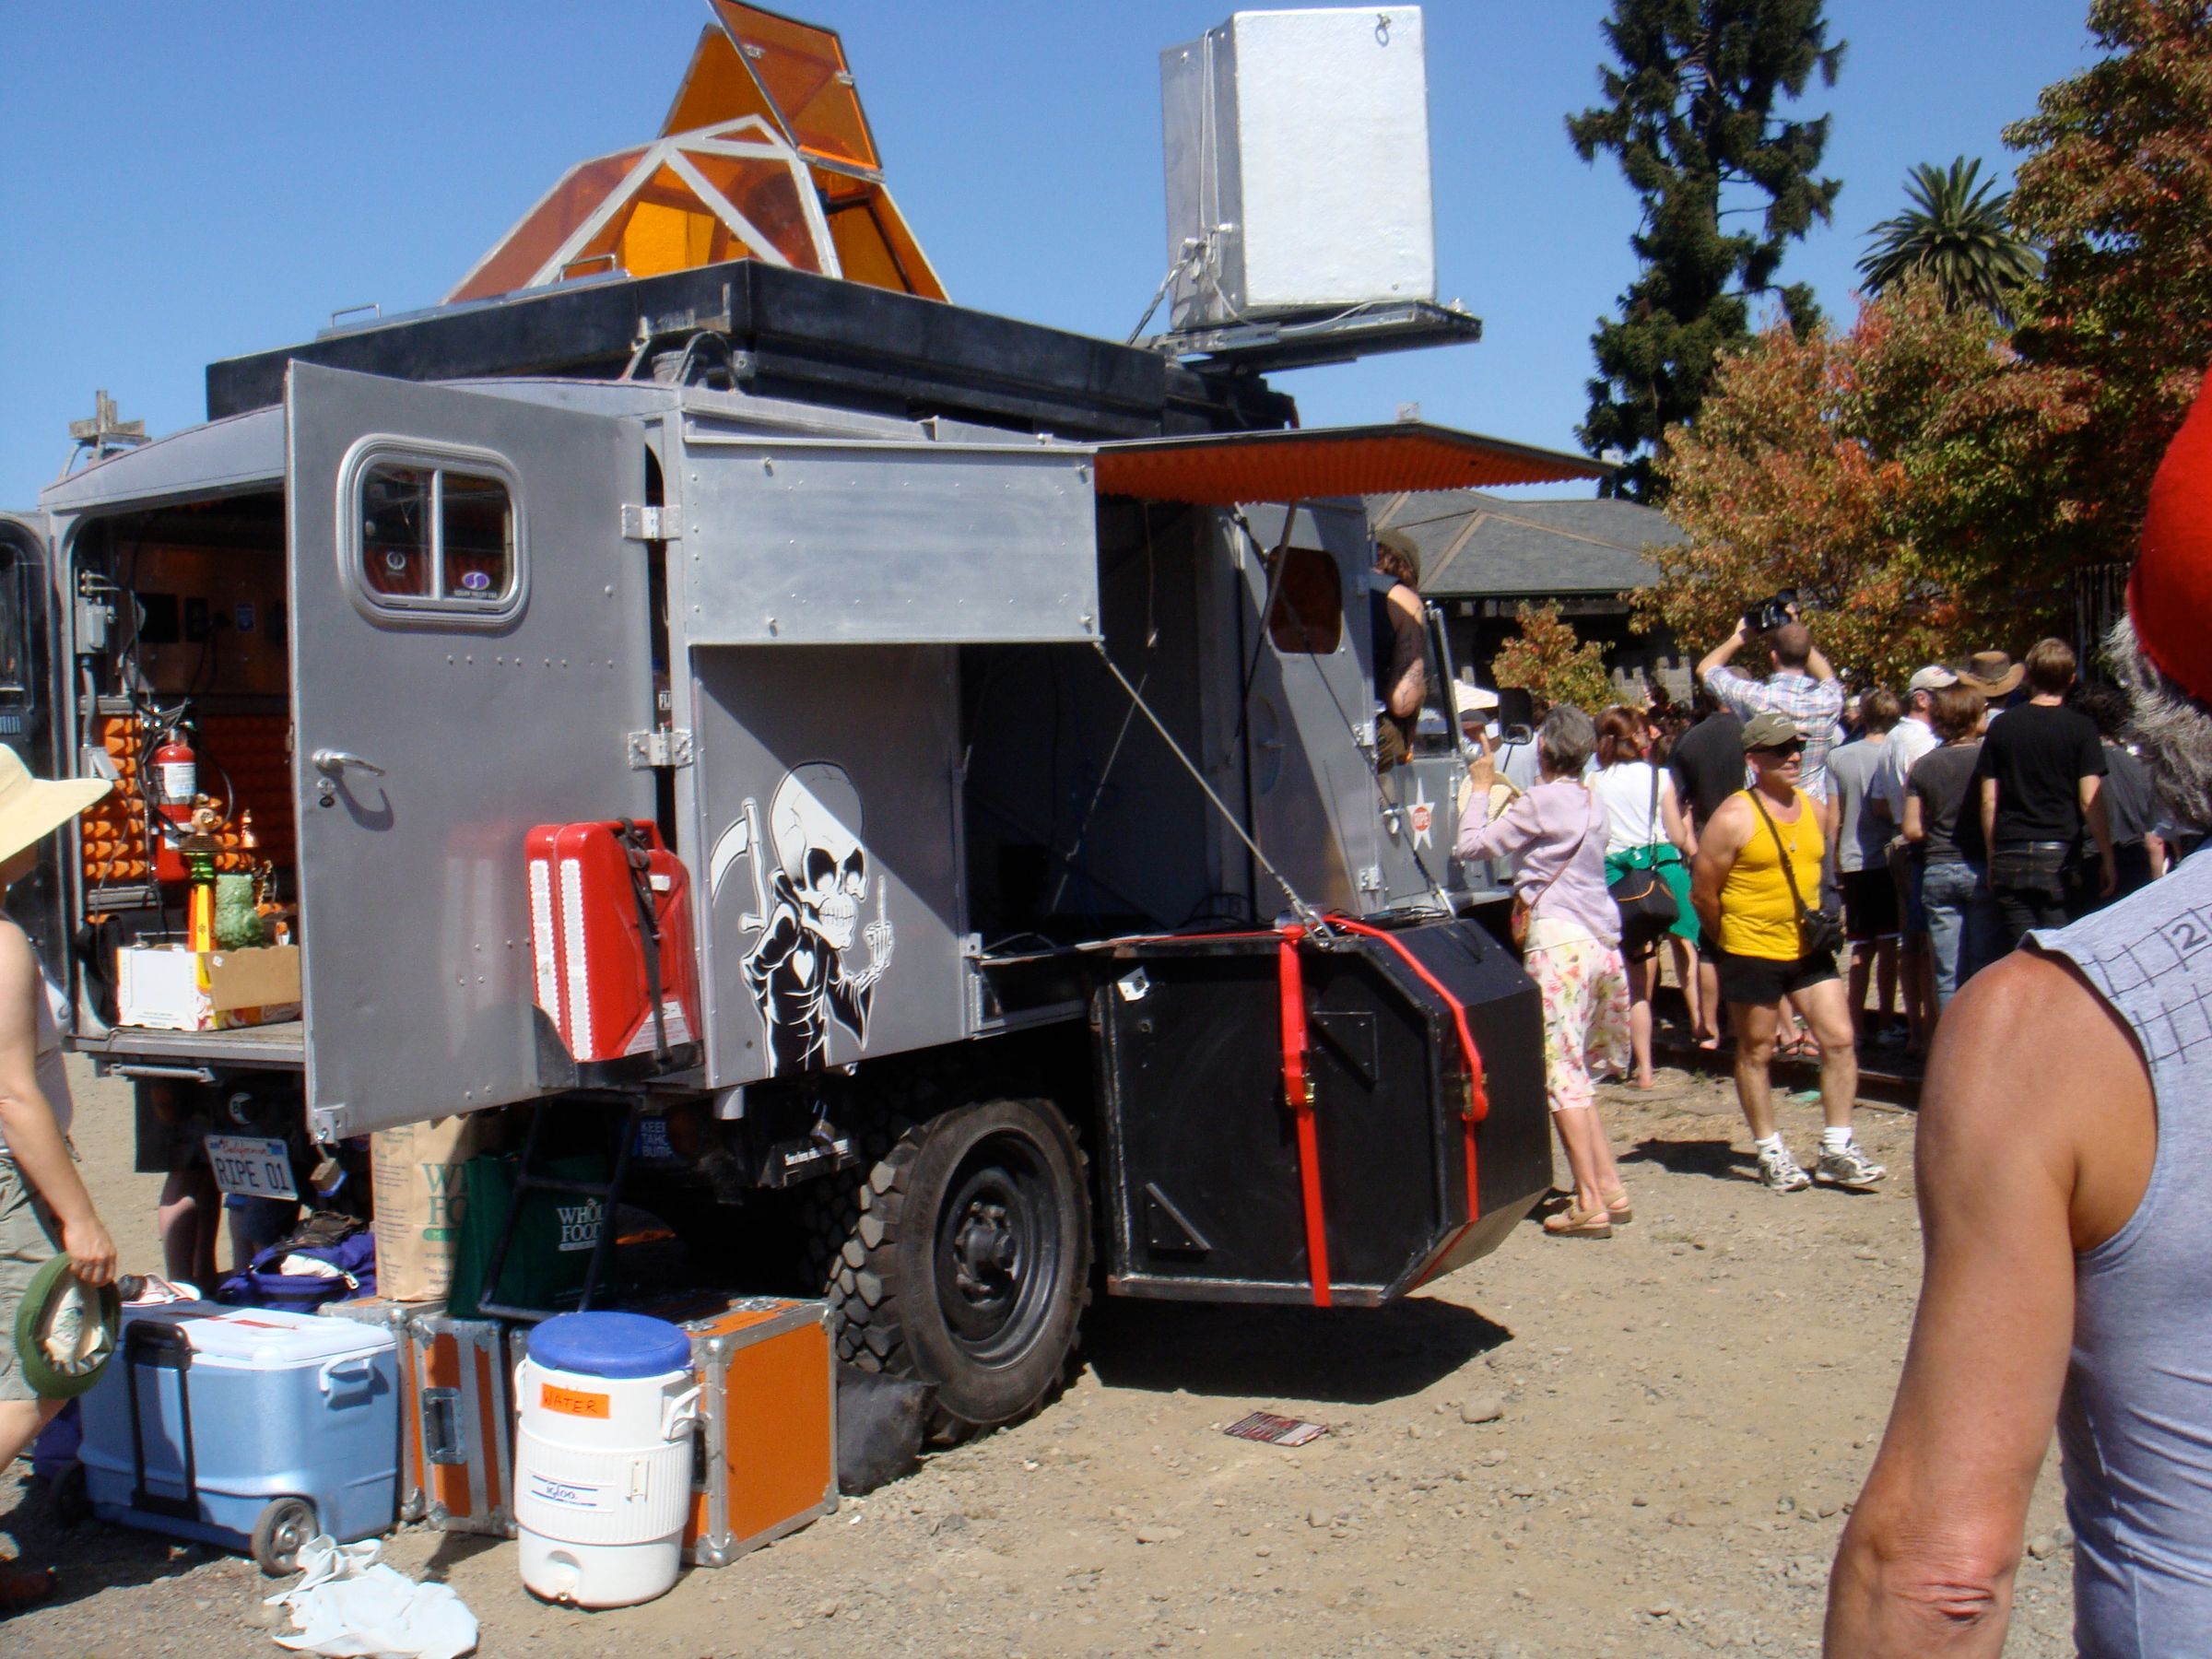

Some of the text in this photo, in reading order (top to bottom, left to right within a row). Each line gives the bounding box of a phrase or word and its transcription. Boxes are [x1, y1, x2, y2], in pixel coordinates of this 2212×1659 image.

[2171, 924, 2207, 950] 2
[215, 1158, 260, 1188] RIPE
[556, 1204, 604, 1225] WHOL
[544, 1391, 598, 1415] WATER
